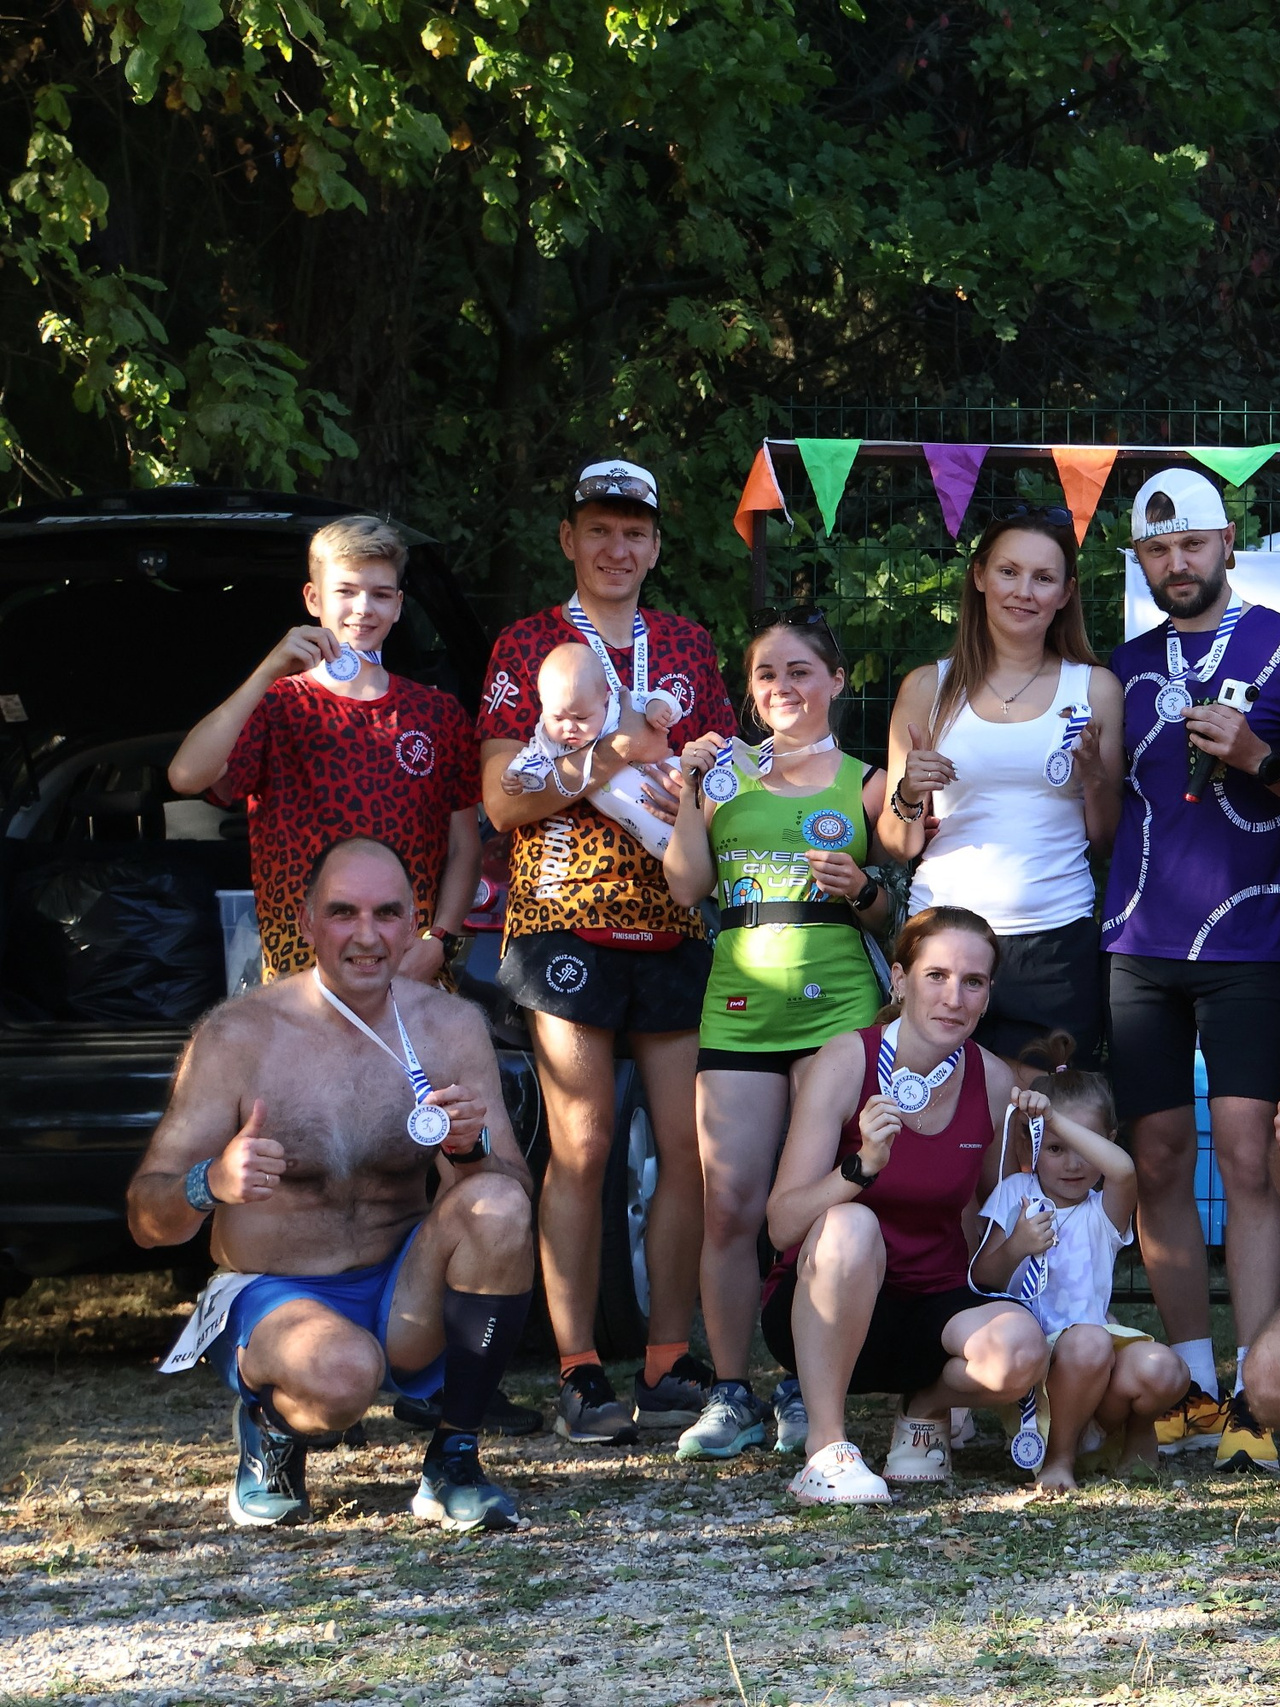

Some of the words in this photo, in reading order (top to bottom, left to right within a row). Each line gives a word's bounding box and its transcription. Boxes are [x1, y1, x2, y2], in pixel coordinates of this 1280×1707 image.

[593, 640, 606, 661] 2024
[637, 642, 645, 662] 2024
[1200, 664, 1216, 681] ATTLE
[1210, 643, 1224, 663] 2024
[637, 663, 645, 692] BATTLE
[1217, 796, 1252, 832] #УДИВЛЕНИЕ
[717, 849, 811, 864] NEVER
[742, 862, 810, 876] GIVE
[766, 876, 809, 888] UP
[1206, 899, 1233, 928] #ТРЕПЕТ
[933, 1067, 948, 1082] 2024
[481, 1316, 497, 1347] KIPSTA
